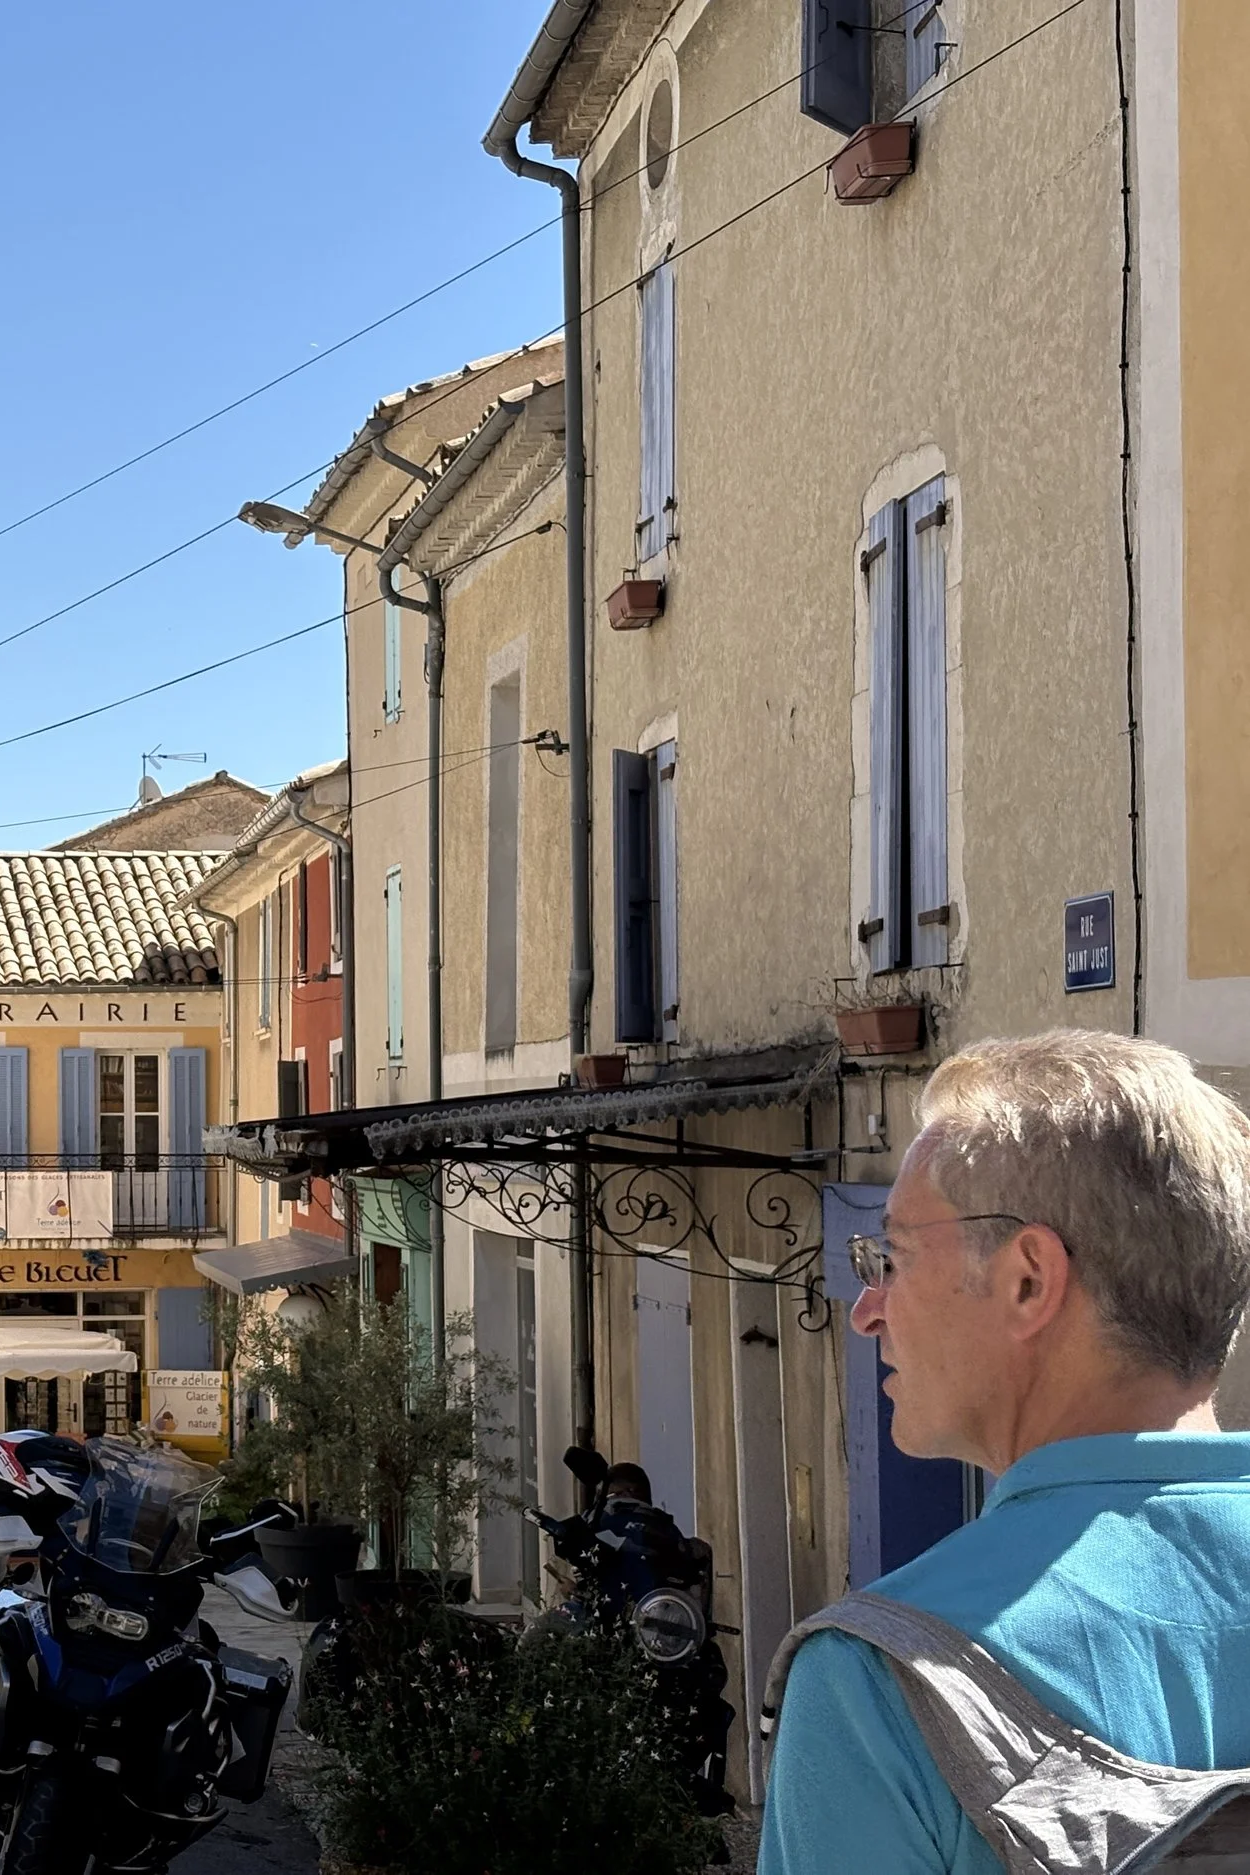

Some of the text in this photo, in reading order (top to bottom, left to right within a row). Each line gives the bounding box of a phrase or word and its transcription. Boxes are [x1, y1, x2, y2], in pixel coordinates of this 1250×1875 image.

[1080, 914, 1094, 938] RUE
[1067, 946, 1108, 973] SAINT JUST
[150, 1371, 220, 1386] Terre adélice
[186, 1391, 218, 1401] Glacier
[196, 1405, 208, 1415] de
[188, 1420, 217, 1429] nature
